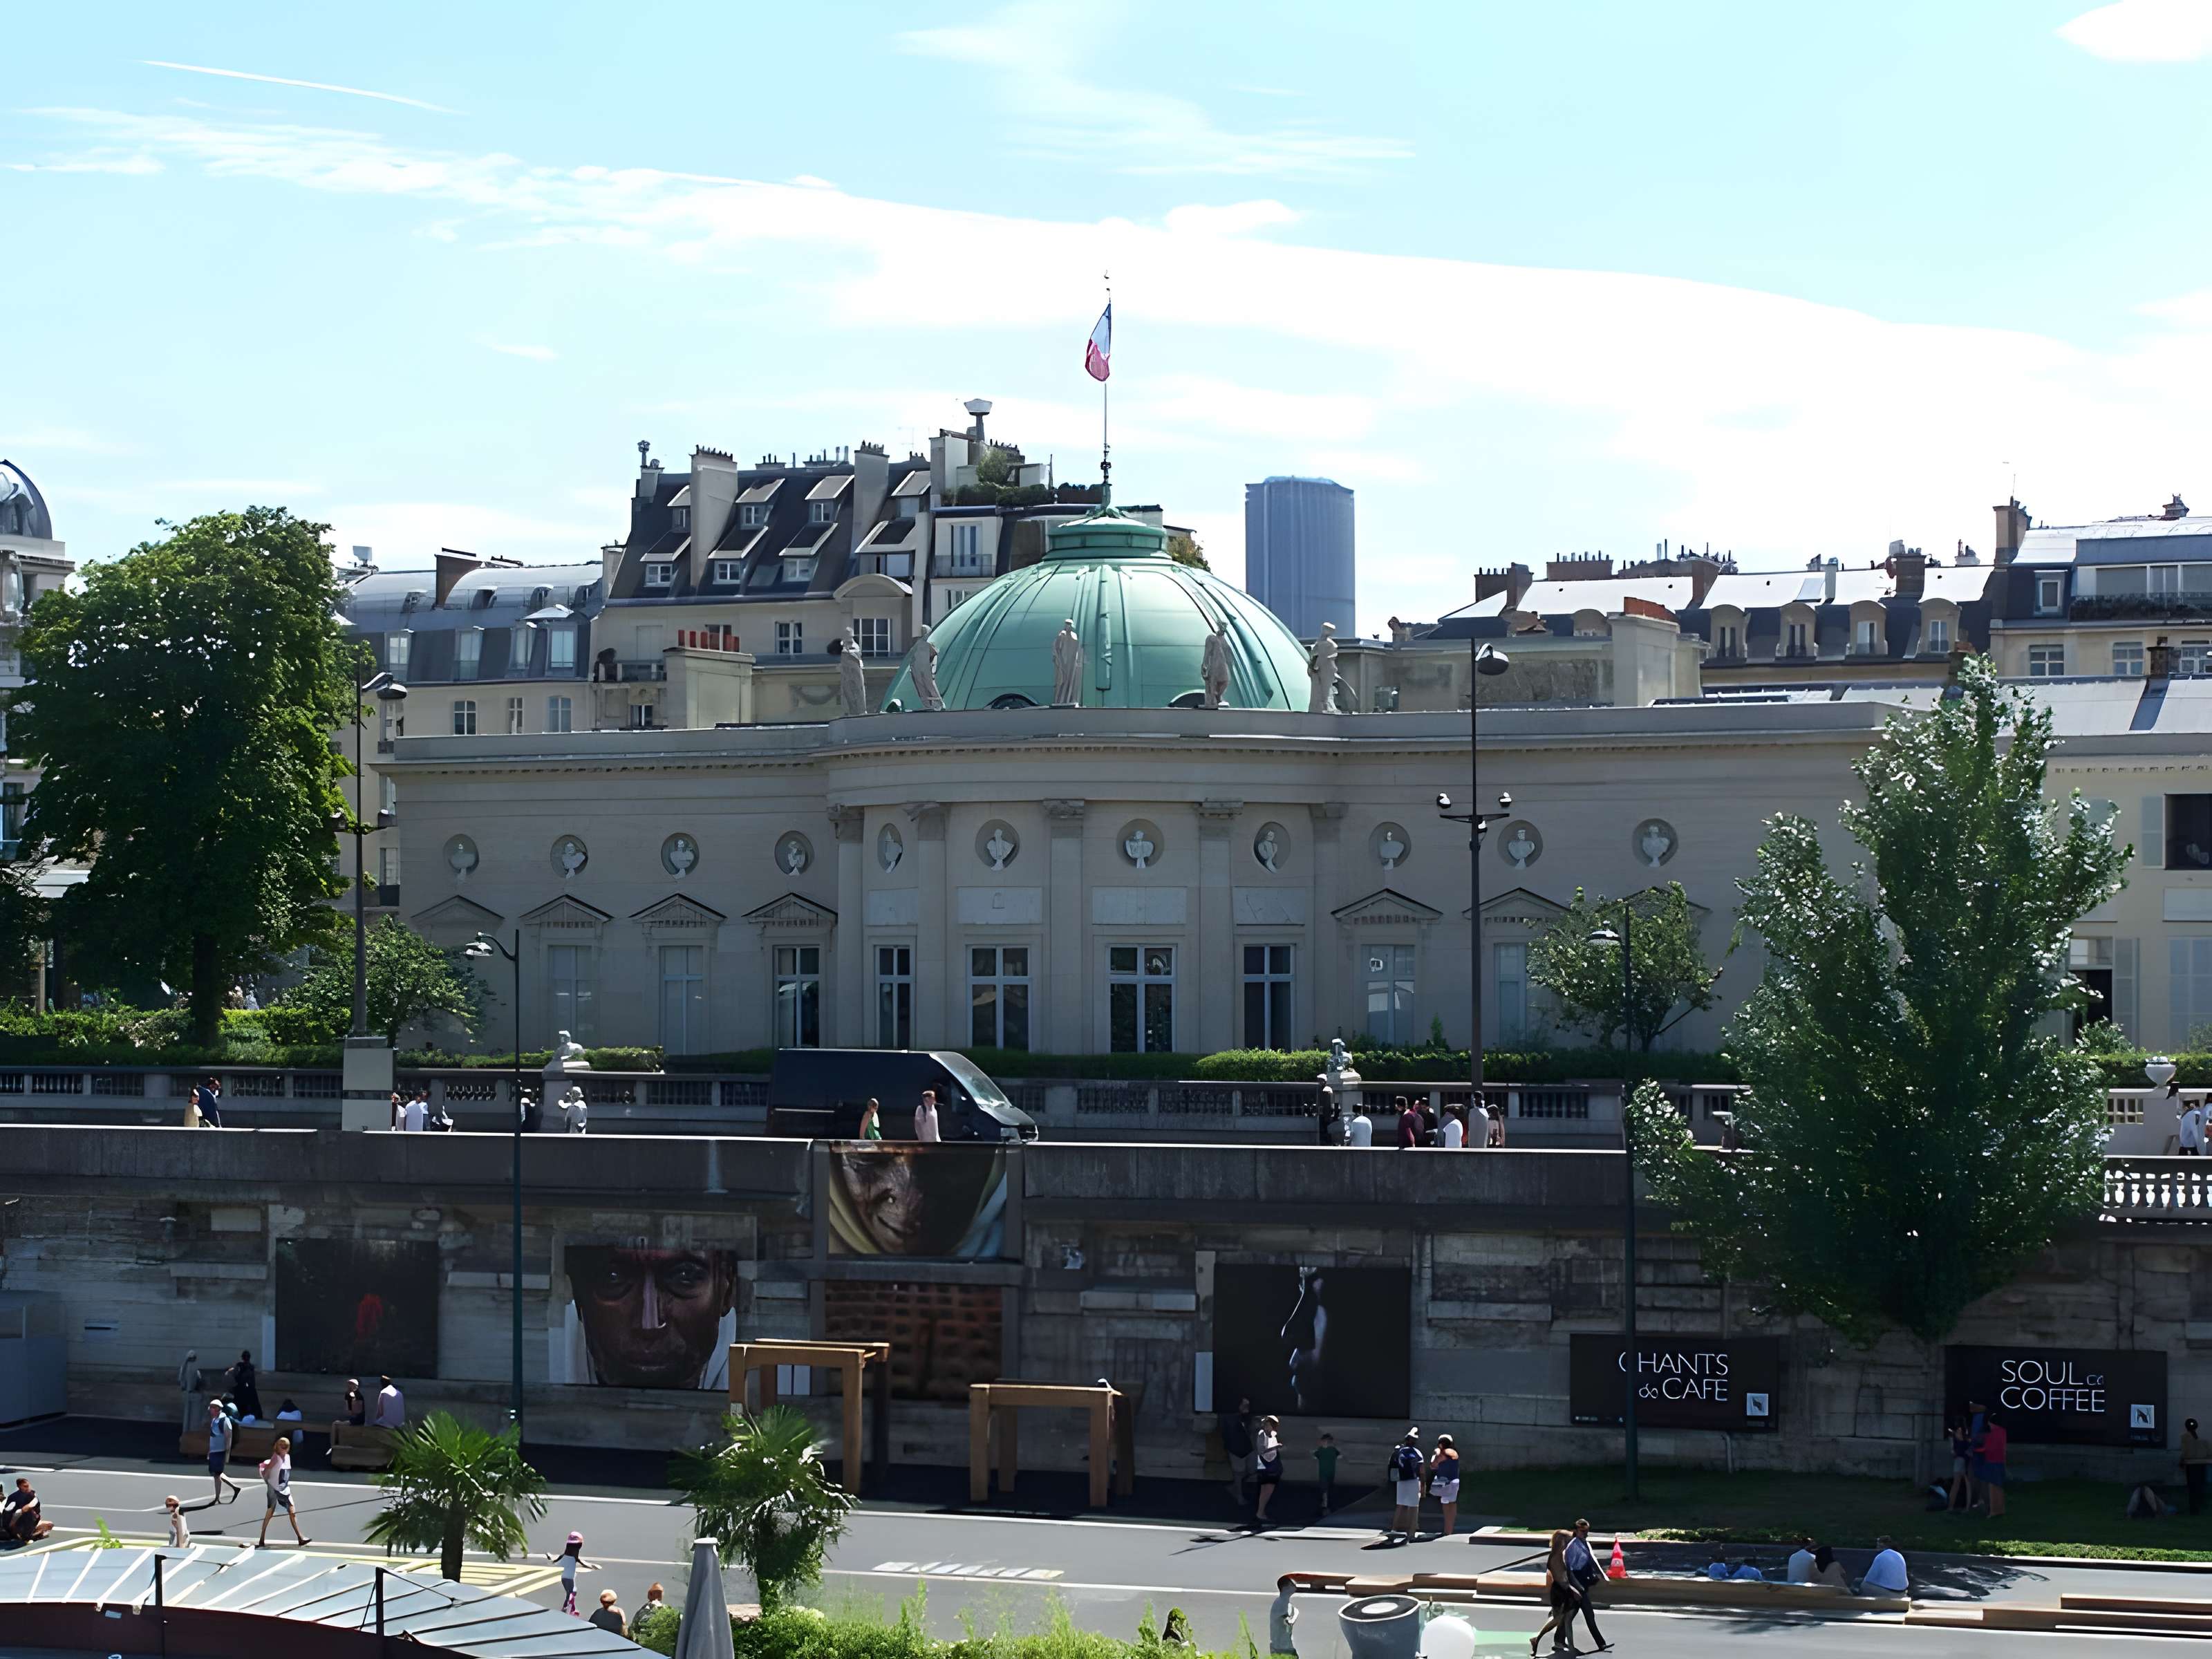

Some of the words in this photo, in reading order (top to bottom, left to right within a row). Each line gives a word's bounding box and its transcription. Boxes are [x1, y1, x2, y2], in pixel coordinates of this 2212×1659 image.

[2001, 1360, 2083, 1385] SOUL
[1662, 1377, 1728, 1401] CAFE
[2000, 1386, 2105, 1412] COFFEE
